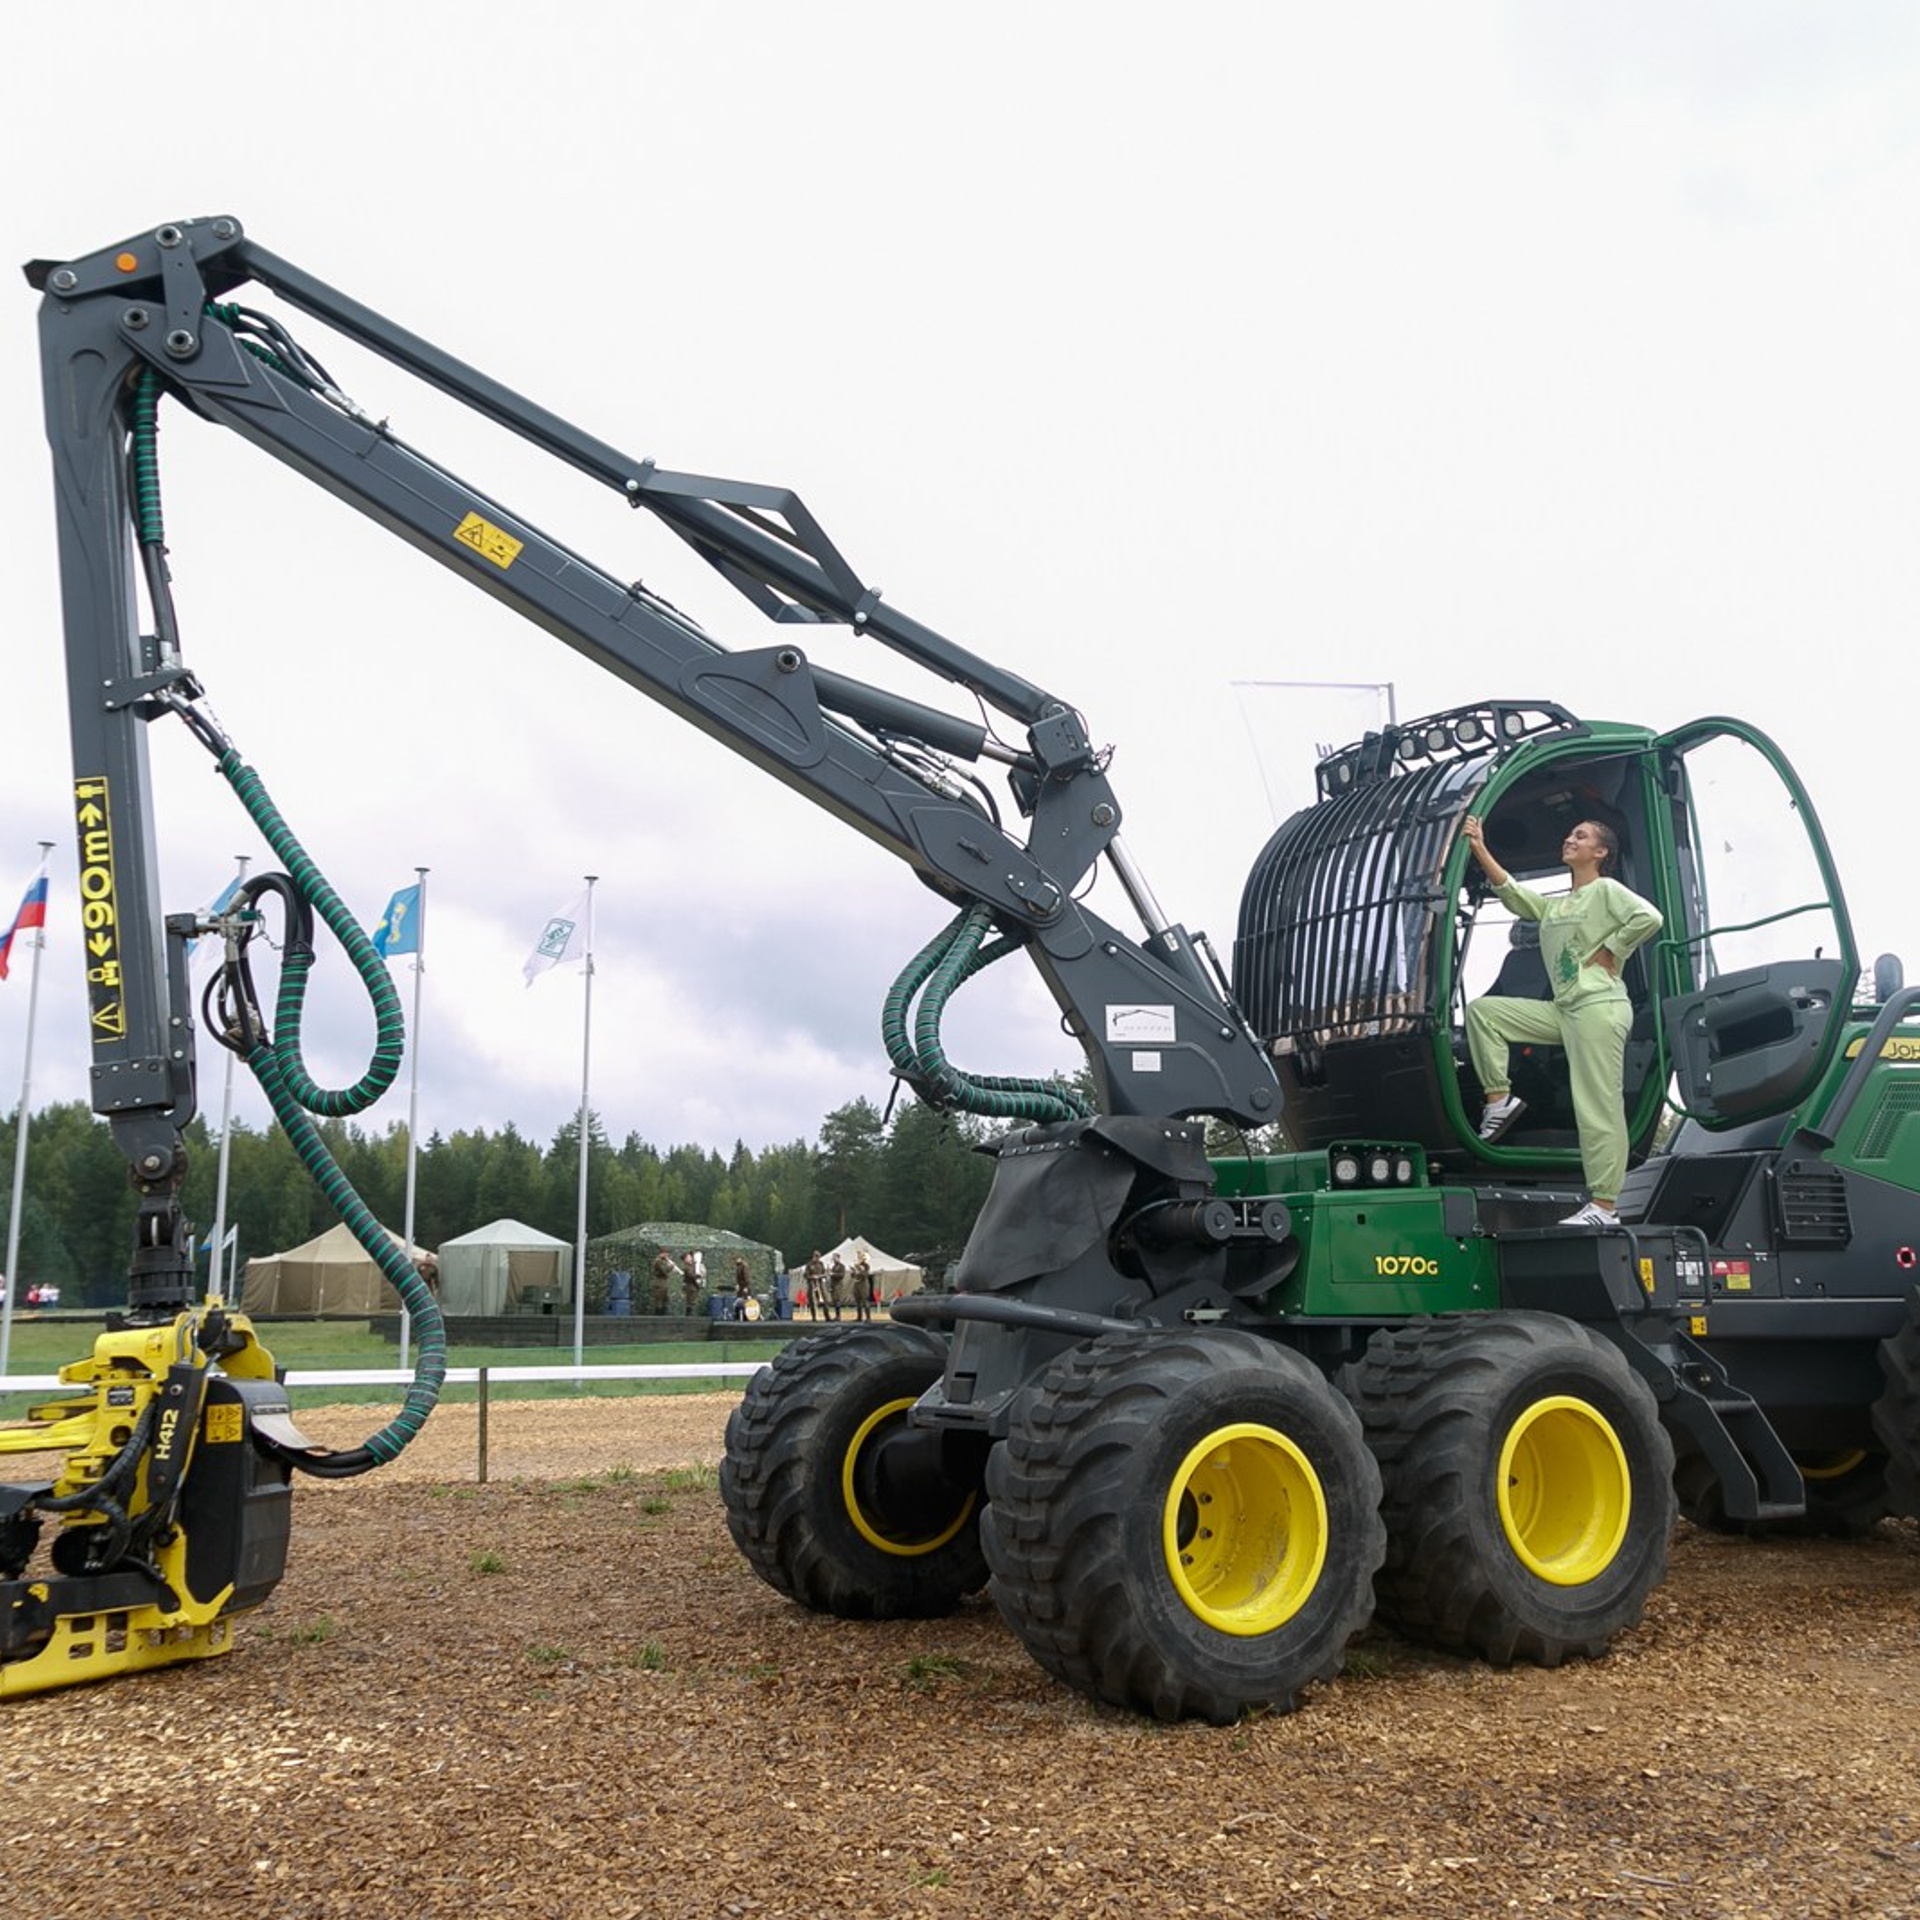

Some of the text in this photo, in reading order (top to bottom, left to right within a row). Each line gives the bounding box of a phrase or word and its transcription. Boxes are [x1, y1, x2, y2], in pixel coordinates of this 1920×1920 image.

[81, 830, 114, 929] 90m
[1375, 1256, 1438, 1275] 1070G
[154, 1409, 179, 1460] H412
